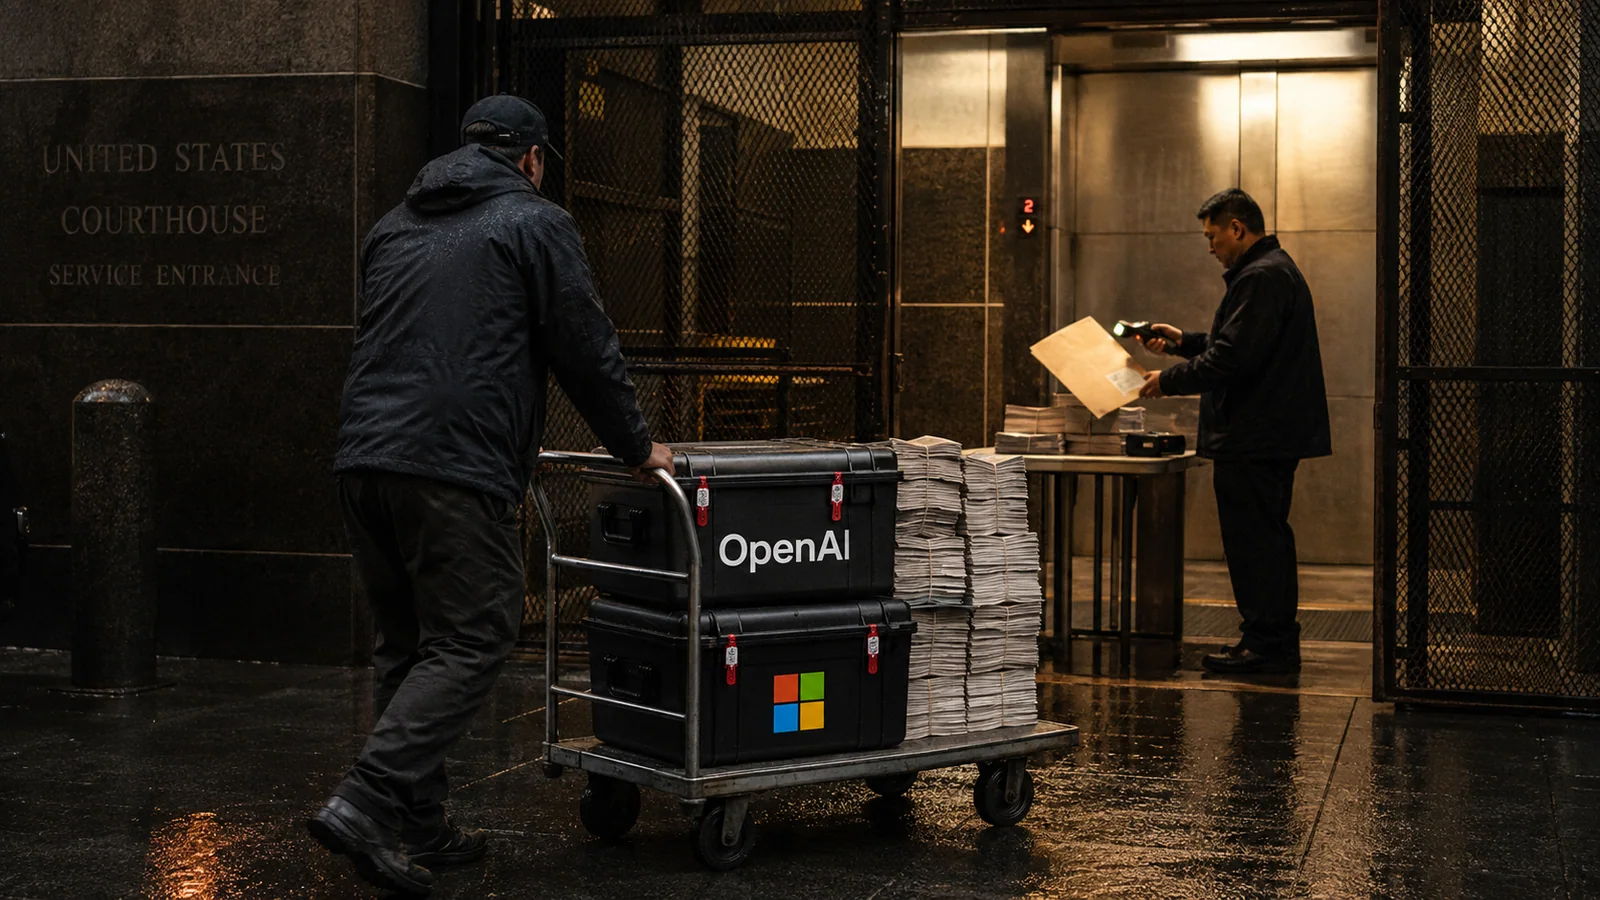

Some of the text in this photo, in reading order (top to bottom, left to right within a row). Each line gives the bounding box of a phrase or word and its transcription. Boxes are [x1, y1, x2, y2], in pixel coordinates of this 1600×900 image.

[43, 142, 286, 174] UNITED STATES
[61, 205, 267, 236] COURTHOUSE
[1023, 199, 1034, 214] 2
[49, 263, 281, 287] SERVICE ENTRANCE
[719, 529, 850, 573] OpenAI
